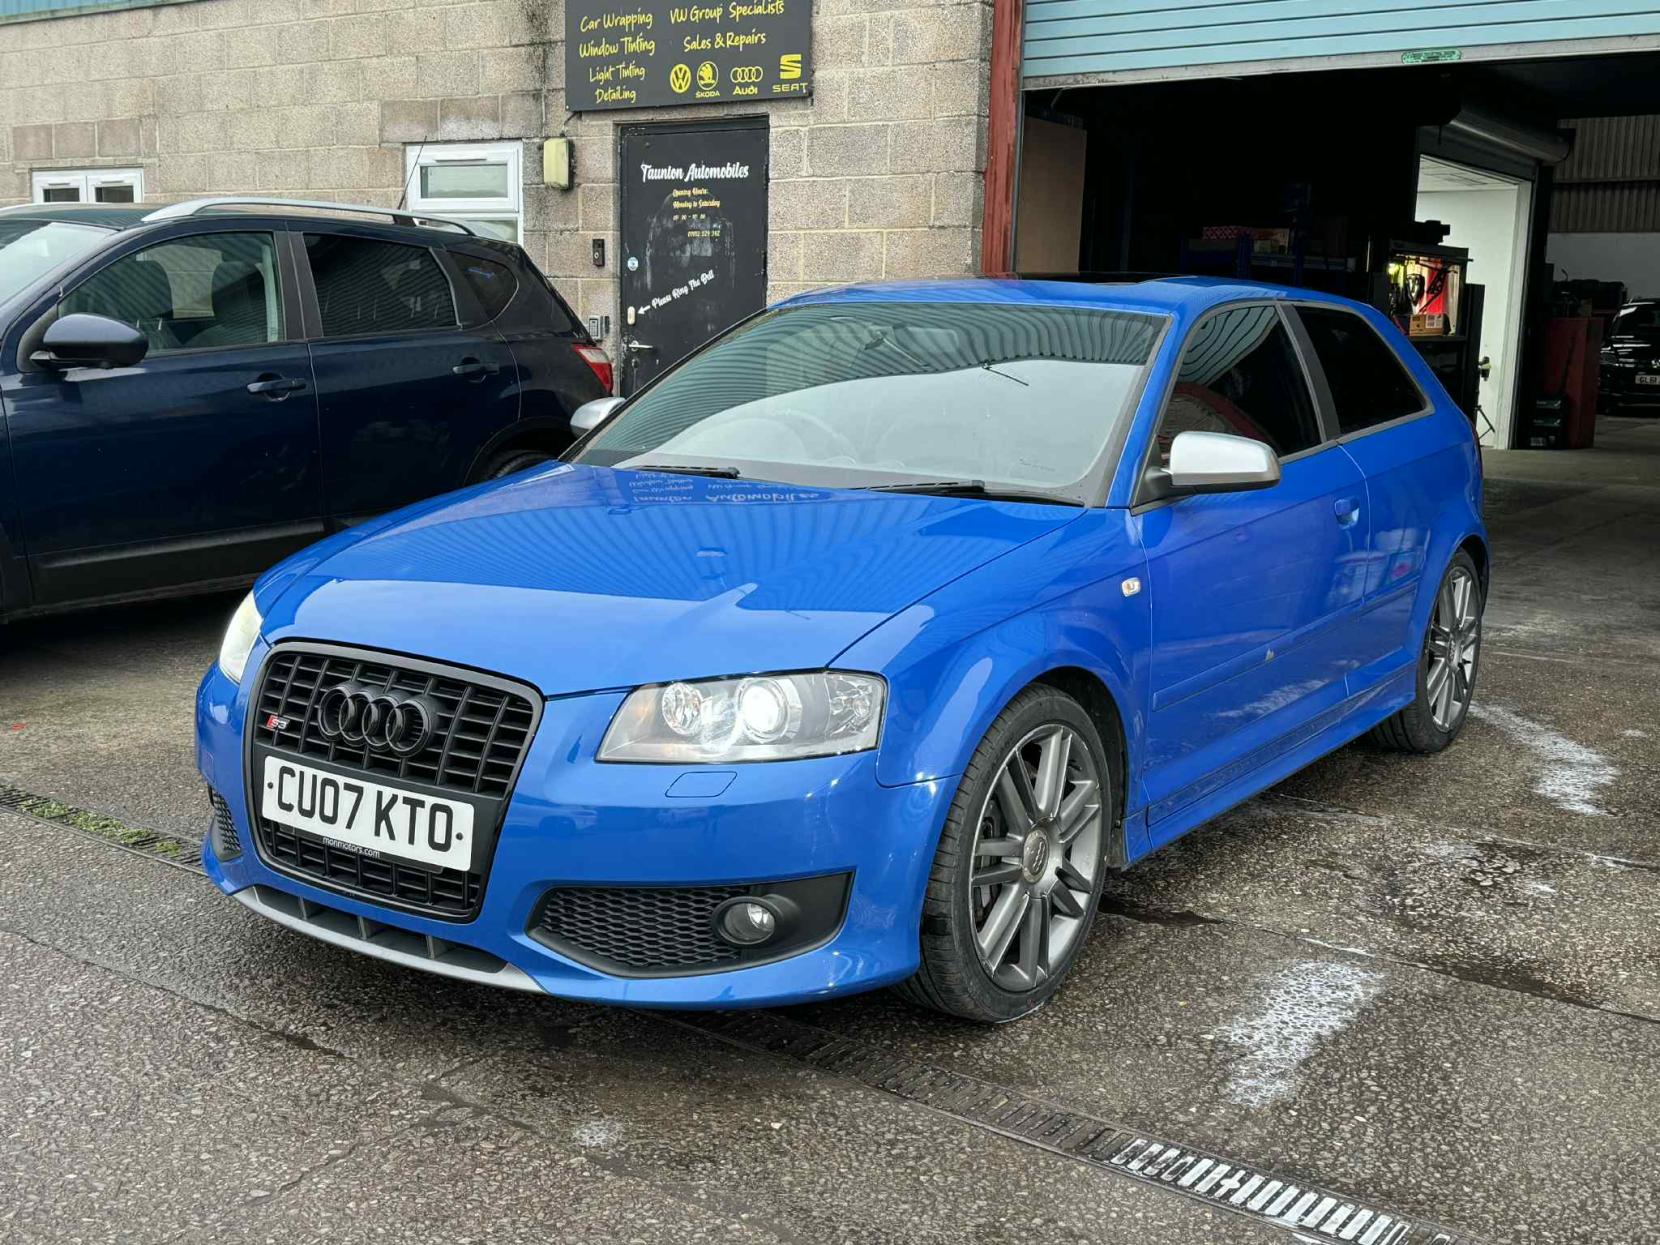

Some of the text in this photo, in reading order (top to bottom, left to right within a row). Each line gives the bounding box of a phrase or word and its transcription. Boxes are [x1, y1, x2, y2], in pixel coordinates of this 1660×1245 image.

[580, 7, 653, 32] Car Wrapping
[670, 0, 785, 24] VW Group Specialists
[579, 32, 656, 58] Window Tinting
[683, 28, 767, 52] Sales & Repairs
[589, 60, 646, 85] Light Tinting
[595, 85, 637, 104] Detailing
[732, 85, 758, 95] Audi
[772, 83, 809, 93] SEAT
[640, 161, 750, 183] Taunton Automobiles
[672, 285, 689, 299] Ring
[688, 278, 701, 291] The
[277, 766, 453, 852] CU07 KTO
[322, 837, 381, 858] monmotors.com
